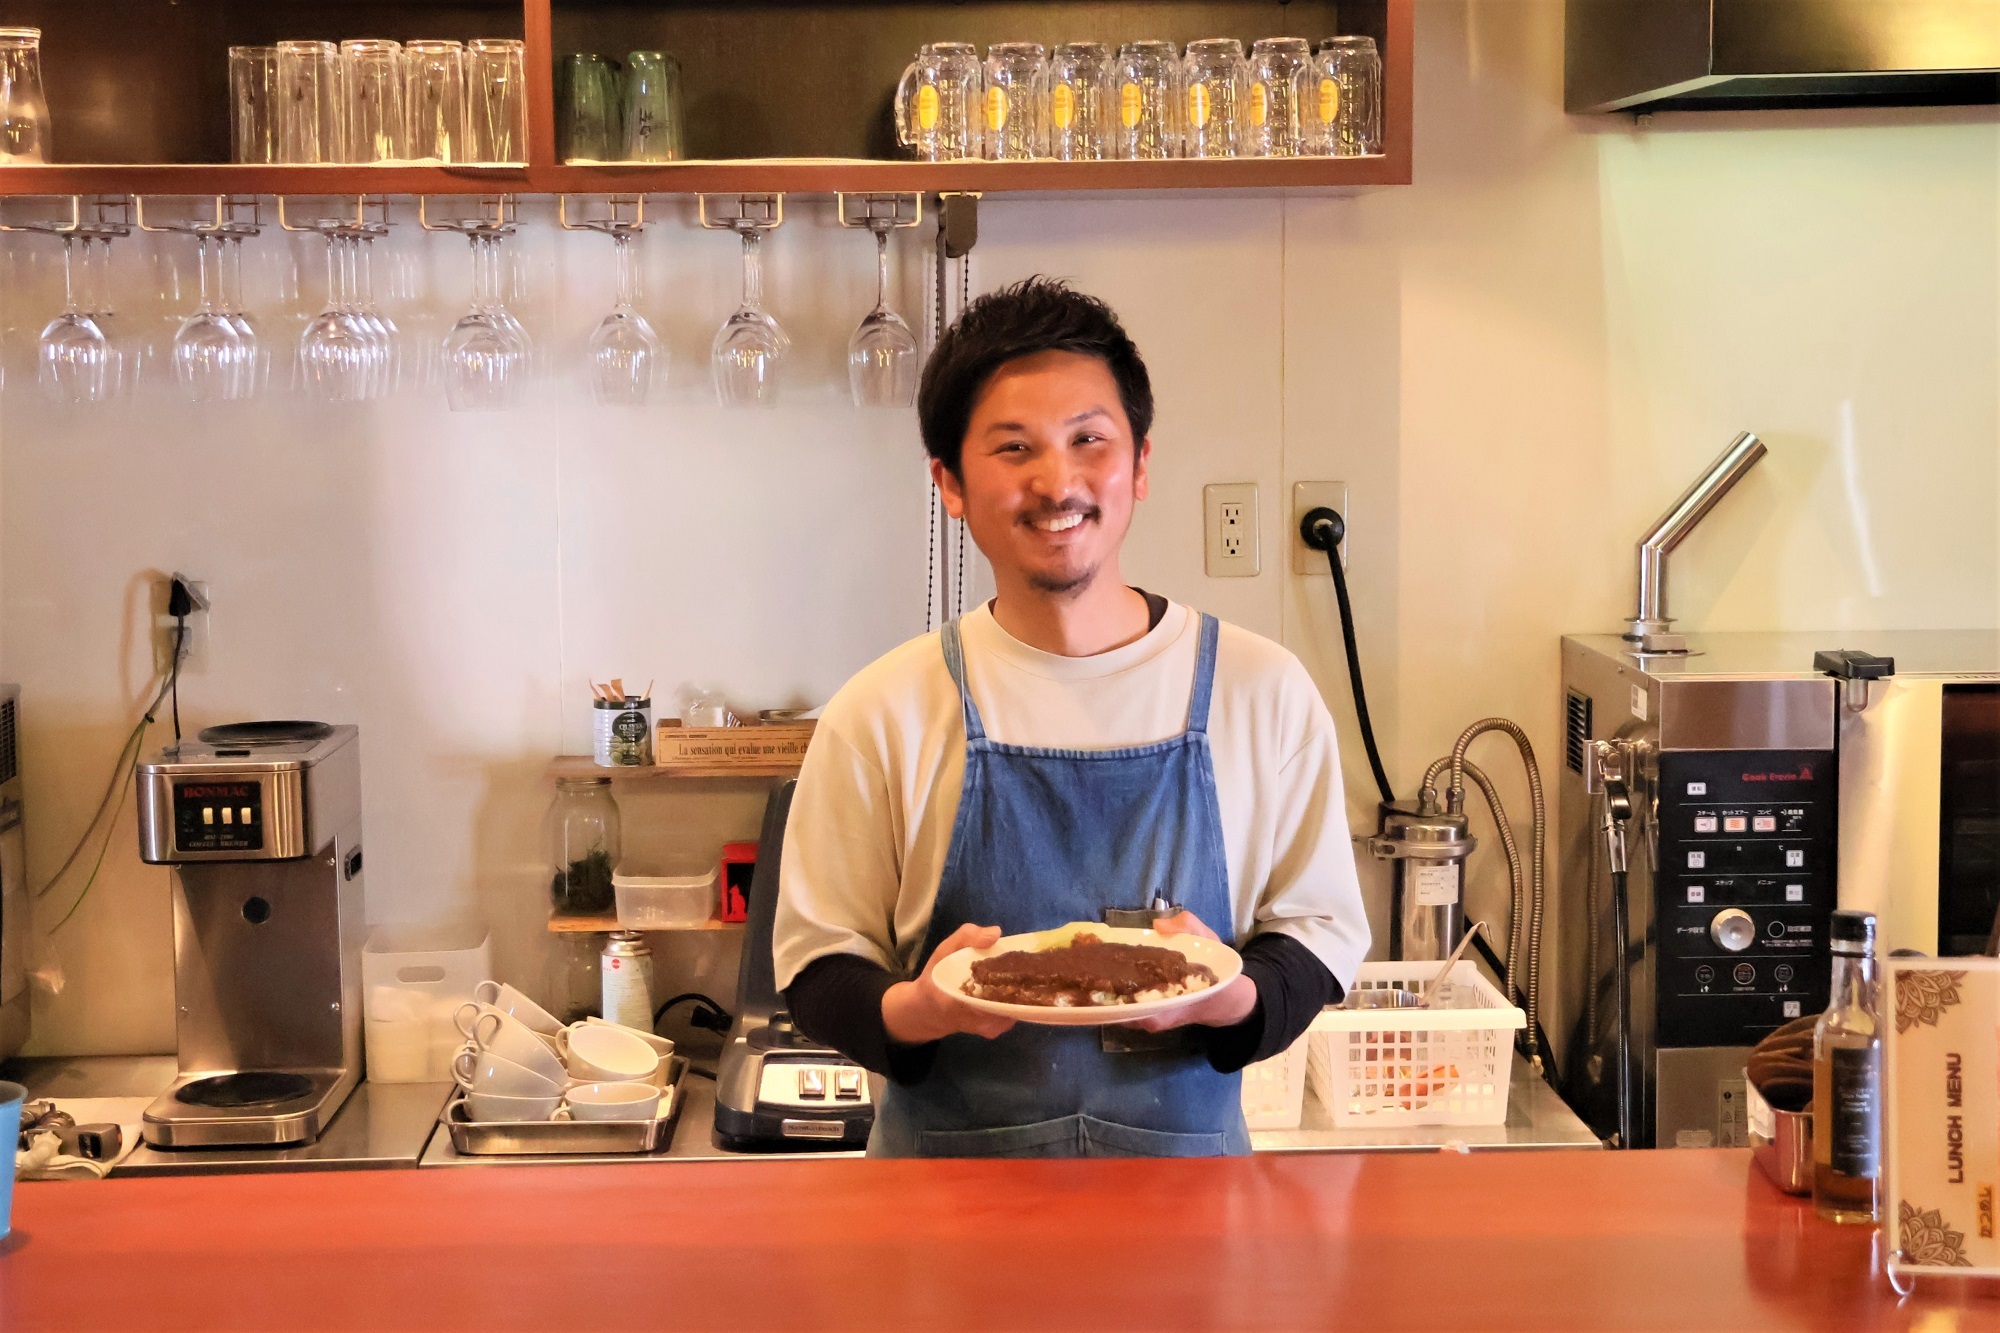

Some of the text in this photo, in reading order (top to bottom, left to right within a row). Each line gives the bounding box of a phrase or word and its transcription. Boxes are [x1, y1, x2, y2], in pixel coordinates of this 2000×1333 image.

[679, 743, 688, 755] La
[691, 743, 722, 755] sensation
[724, 743, 736, 757] qui
[763, 745, 775, 755] une
[777, 742, 799, 754] vieille
[183, 786, 249, 798] BONMAC
[1946, 1052, 1964, 1184] LUNCH MENU
